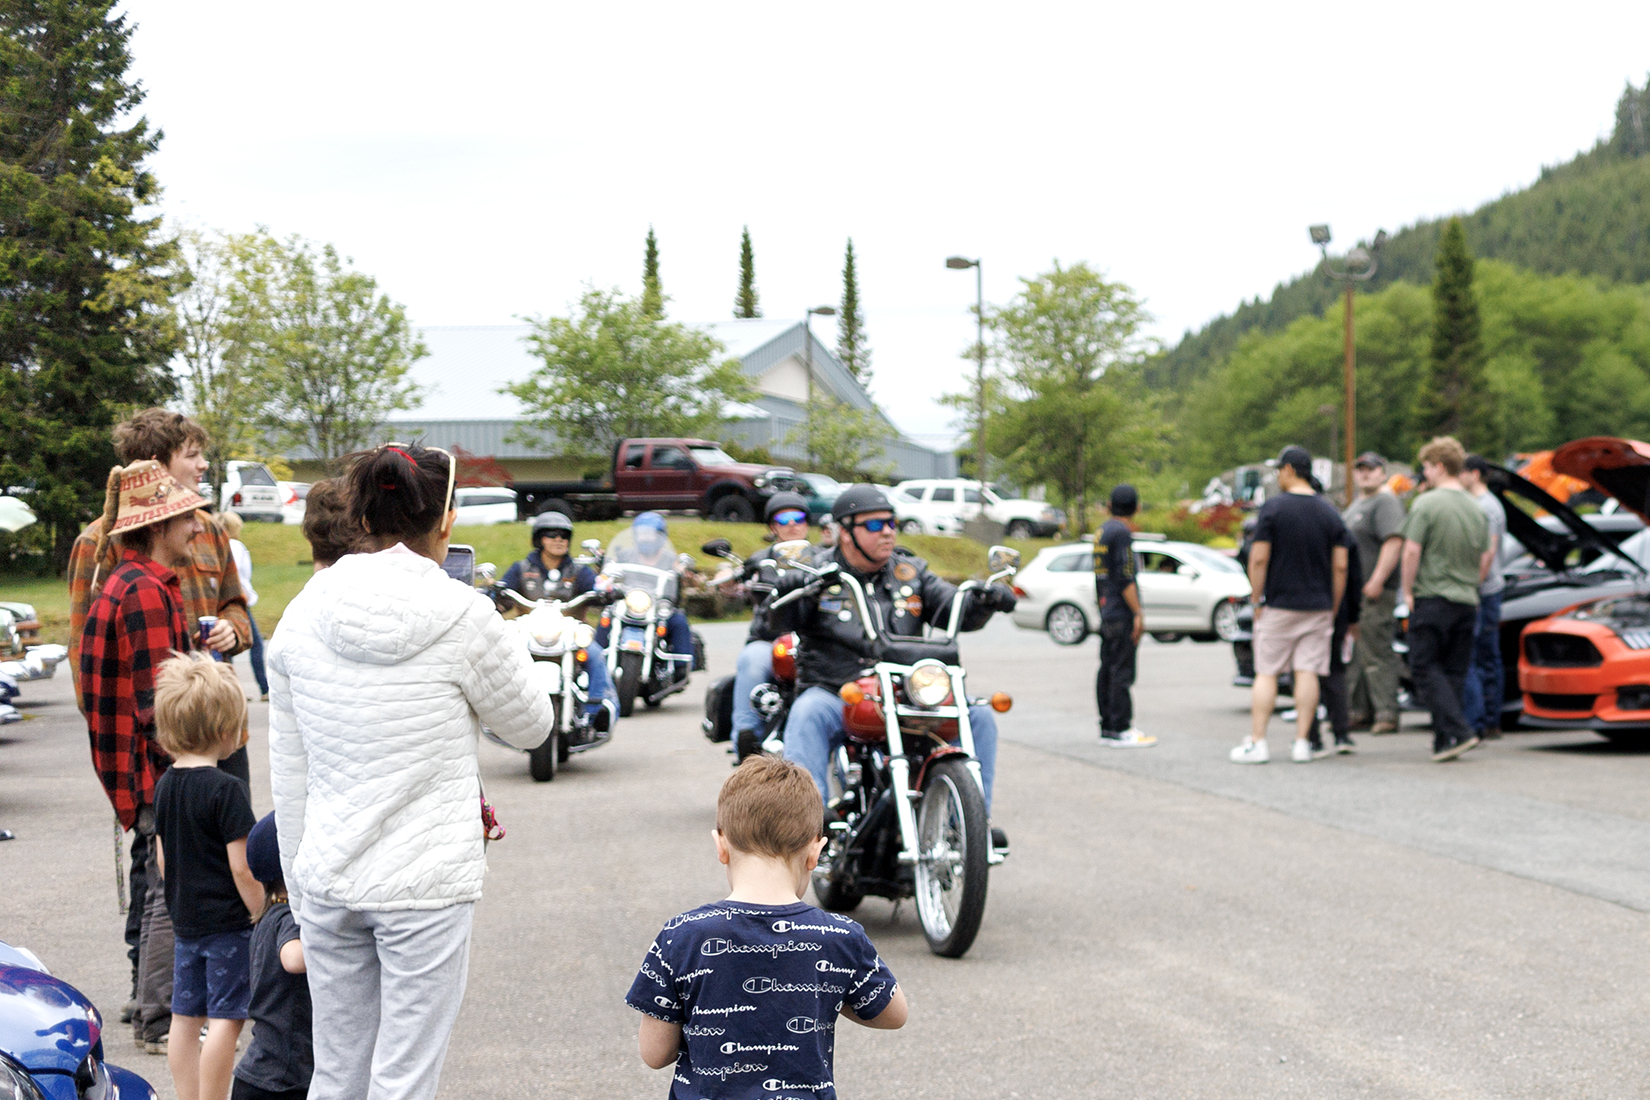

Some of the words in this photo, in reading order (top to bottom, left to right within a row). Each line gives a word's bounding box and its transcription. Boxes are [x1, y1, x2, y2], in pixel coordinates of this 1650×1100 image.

[772, 920, 850, 935] Champion
[700, 938, 822, 959] Champion
[742, 976, 846, 998] Champion
[720, 1041, 800, 1055] Champion
[763, 1079, 836, 1093] Champion
